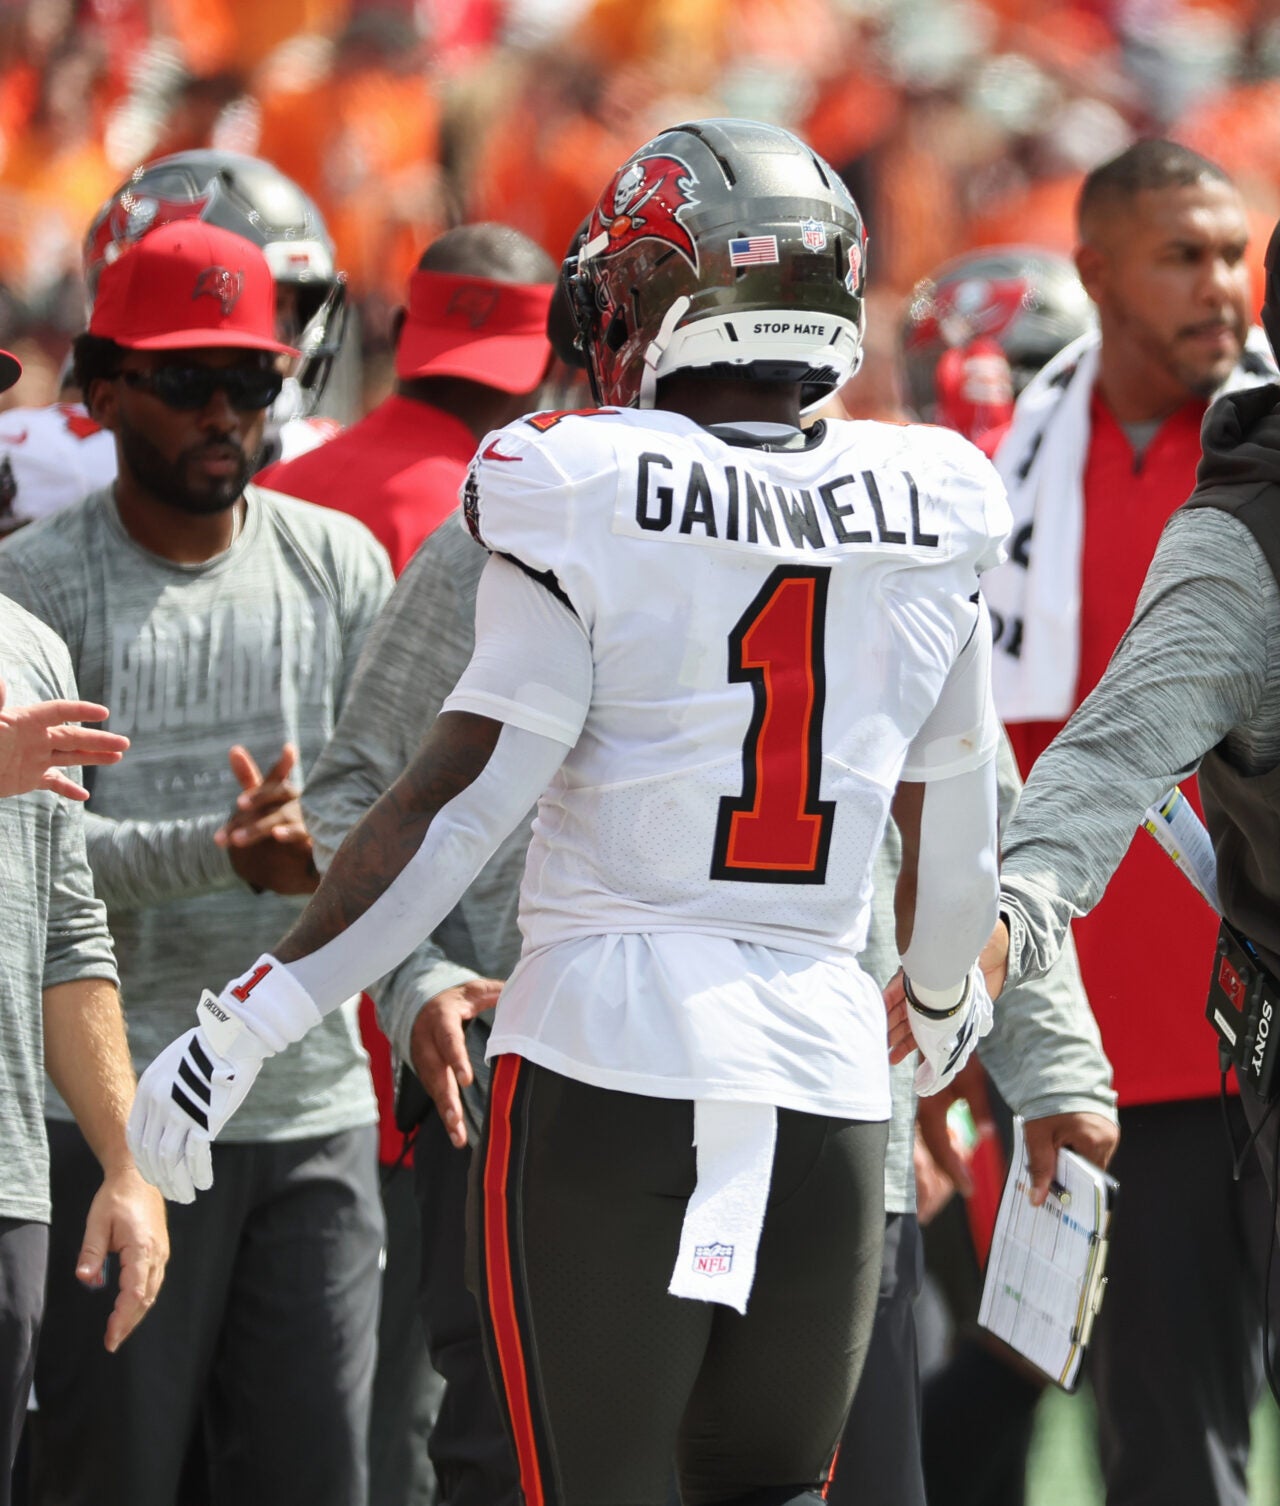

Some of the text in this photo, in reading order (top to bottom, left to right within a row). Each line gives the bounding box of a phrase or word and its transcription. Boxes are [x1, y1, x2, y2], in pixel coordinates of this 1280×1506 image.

[753, 323, 825, 336] STOP HATE
[635, 451, 939, 550] GAINWELL
[710, 564, 837, 885] 1
[230, 963, 273, 1003] 1
[1252, 1000, 1273, 1077] SONY
[695, 1257, 727, 1273] NFL
